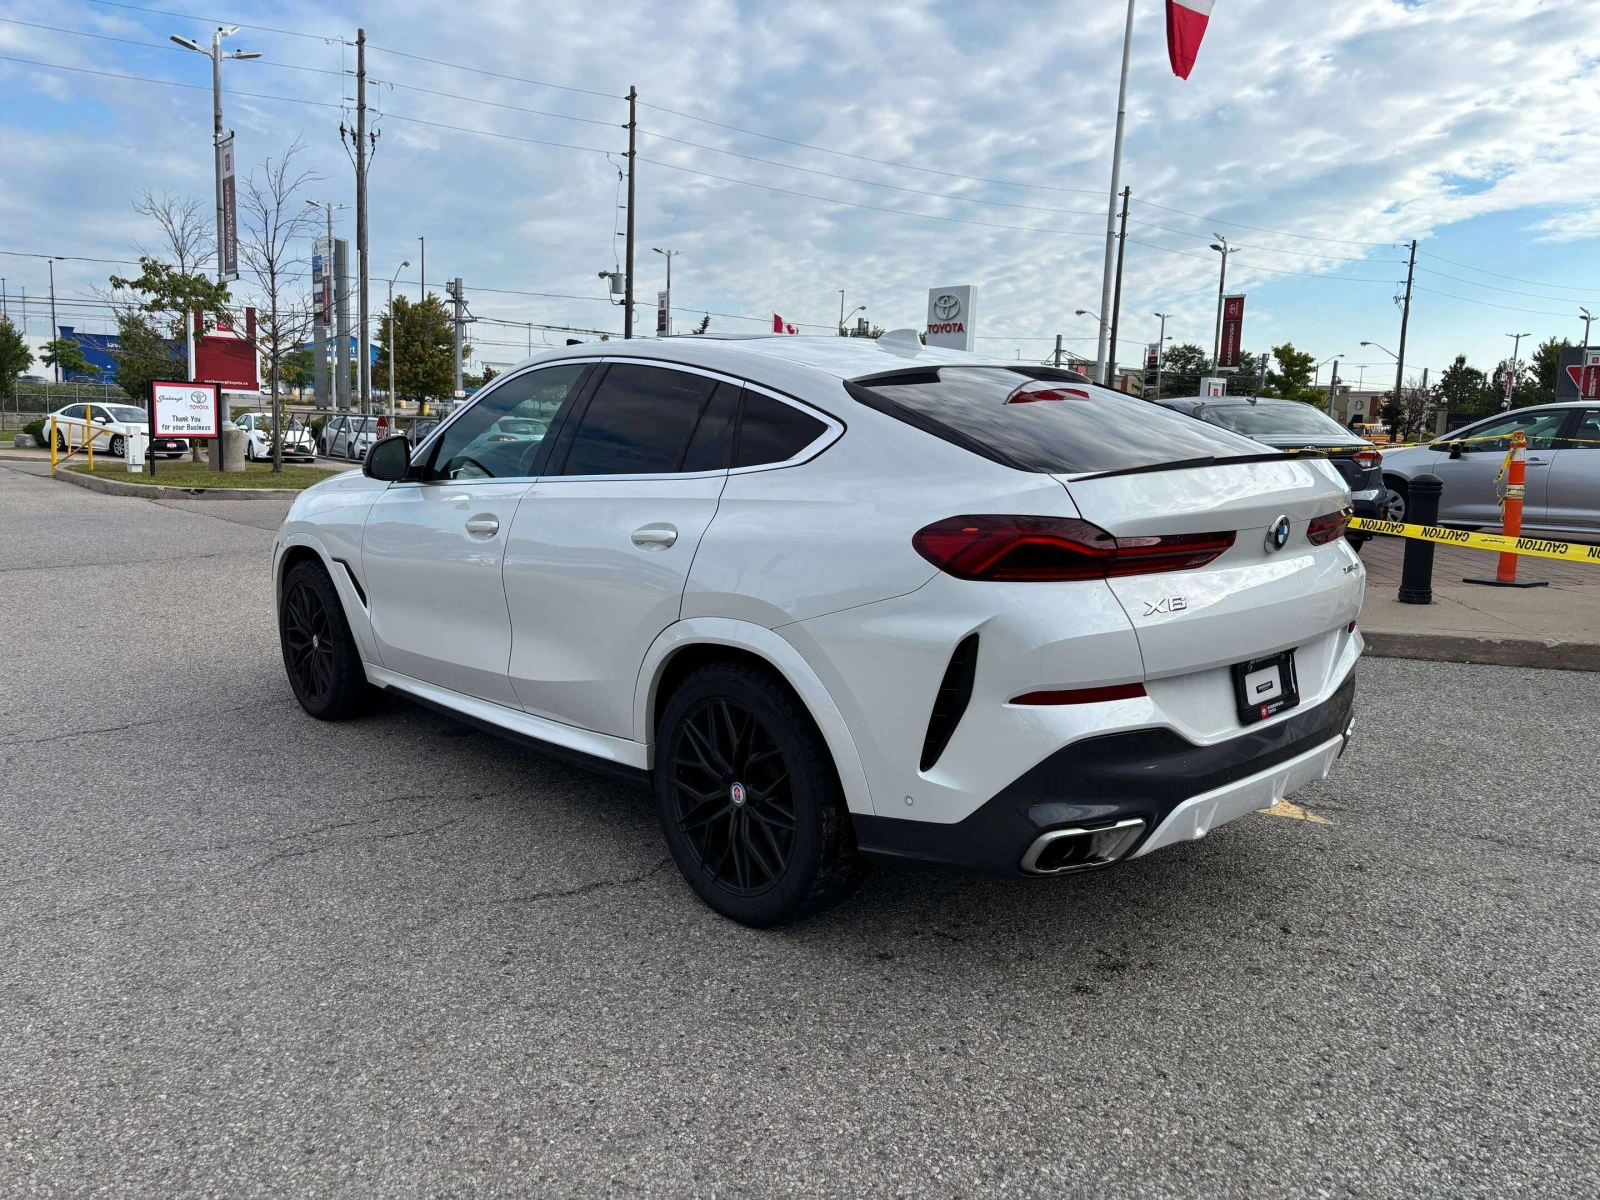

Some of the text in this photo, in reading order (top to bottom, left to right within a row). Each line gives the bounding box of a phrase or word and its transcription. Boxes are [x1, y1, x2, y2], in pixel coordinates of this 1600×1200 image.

[927, 322, 965, 334] TOYOTA
[1227, 323, 1235, 366] SCARBOROUGH
[377, 426, 389, 439] STOP
[1359, 519, 1405, 534] CAUTION
[1420, 527, 1470, 542] CAUTION
[1515, 538, 1568, 554] CAUTION
[1143, 597, 1187, 616] X6
